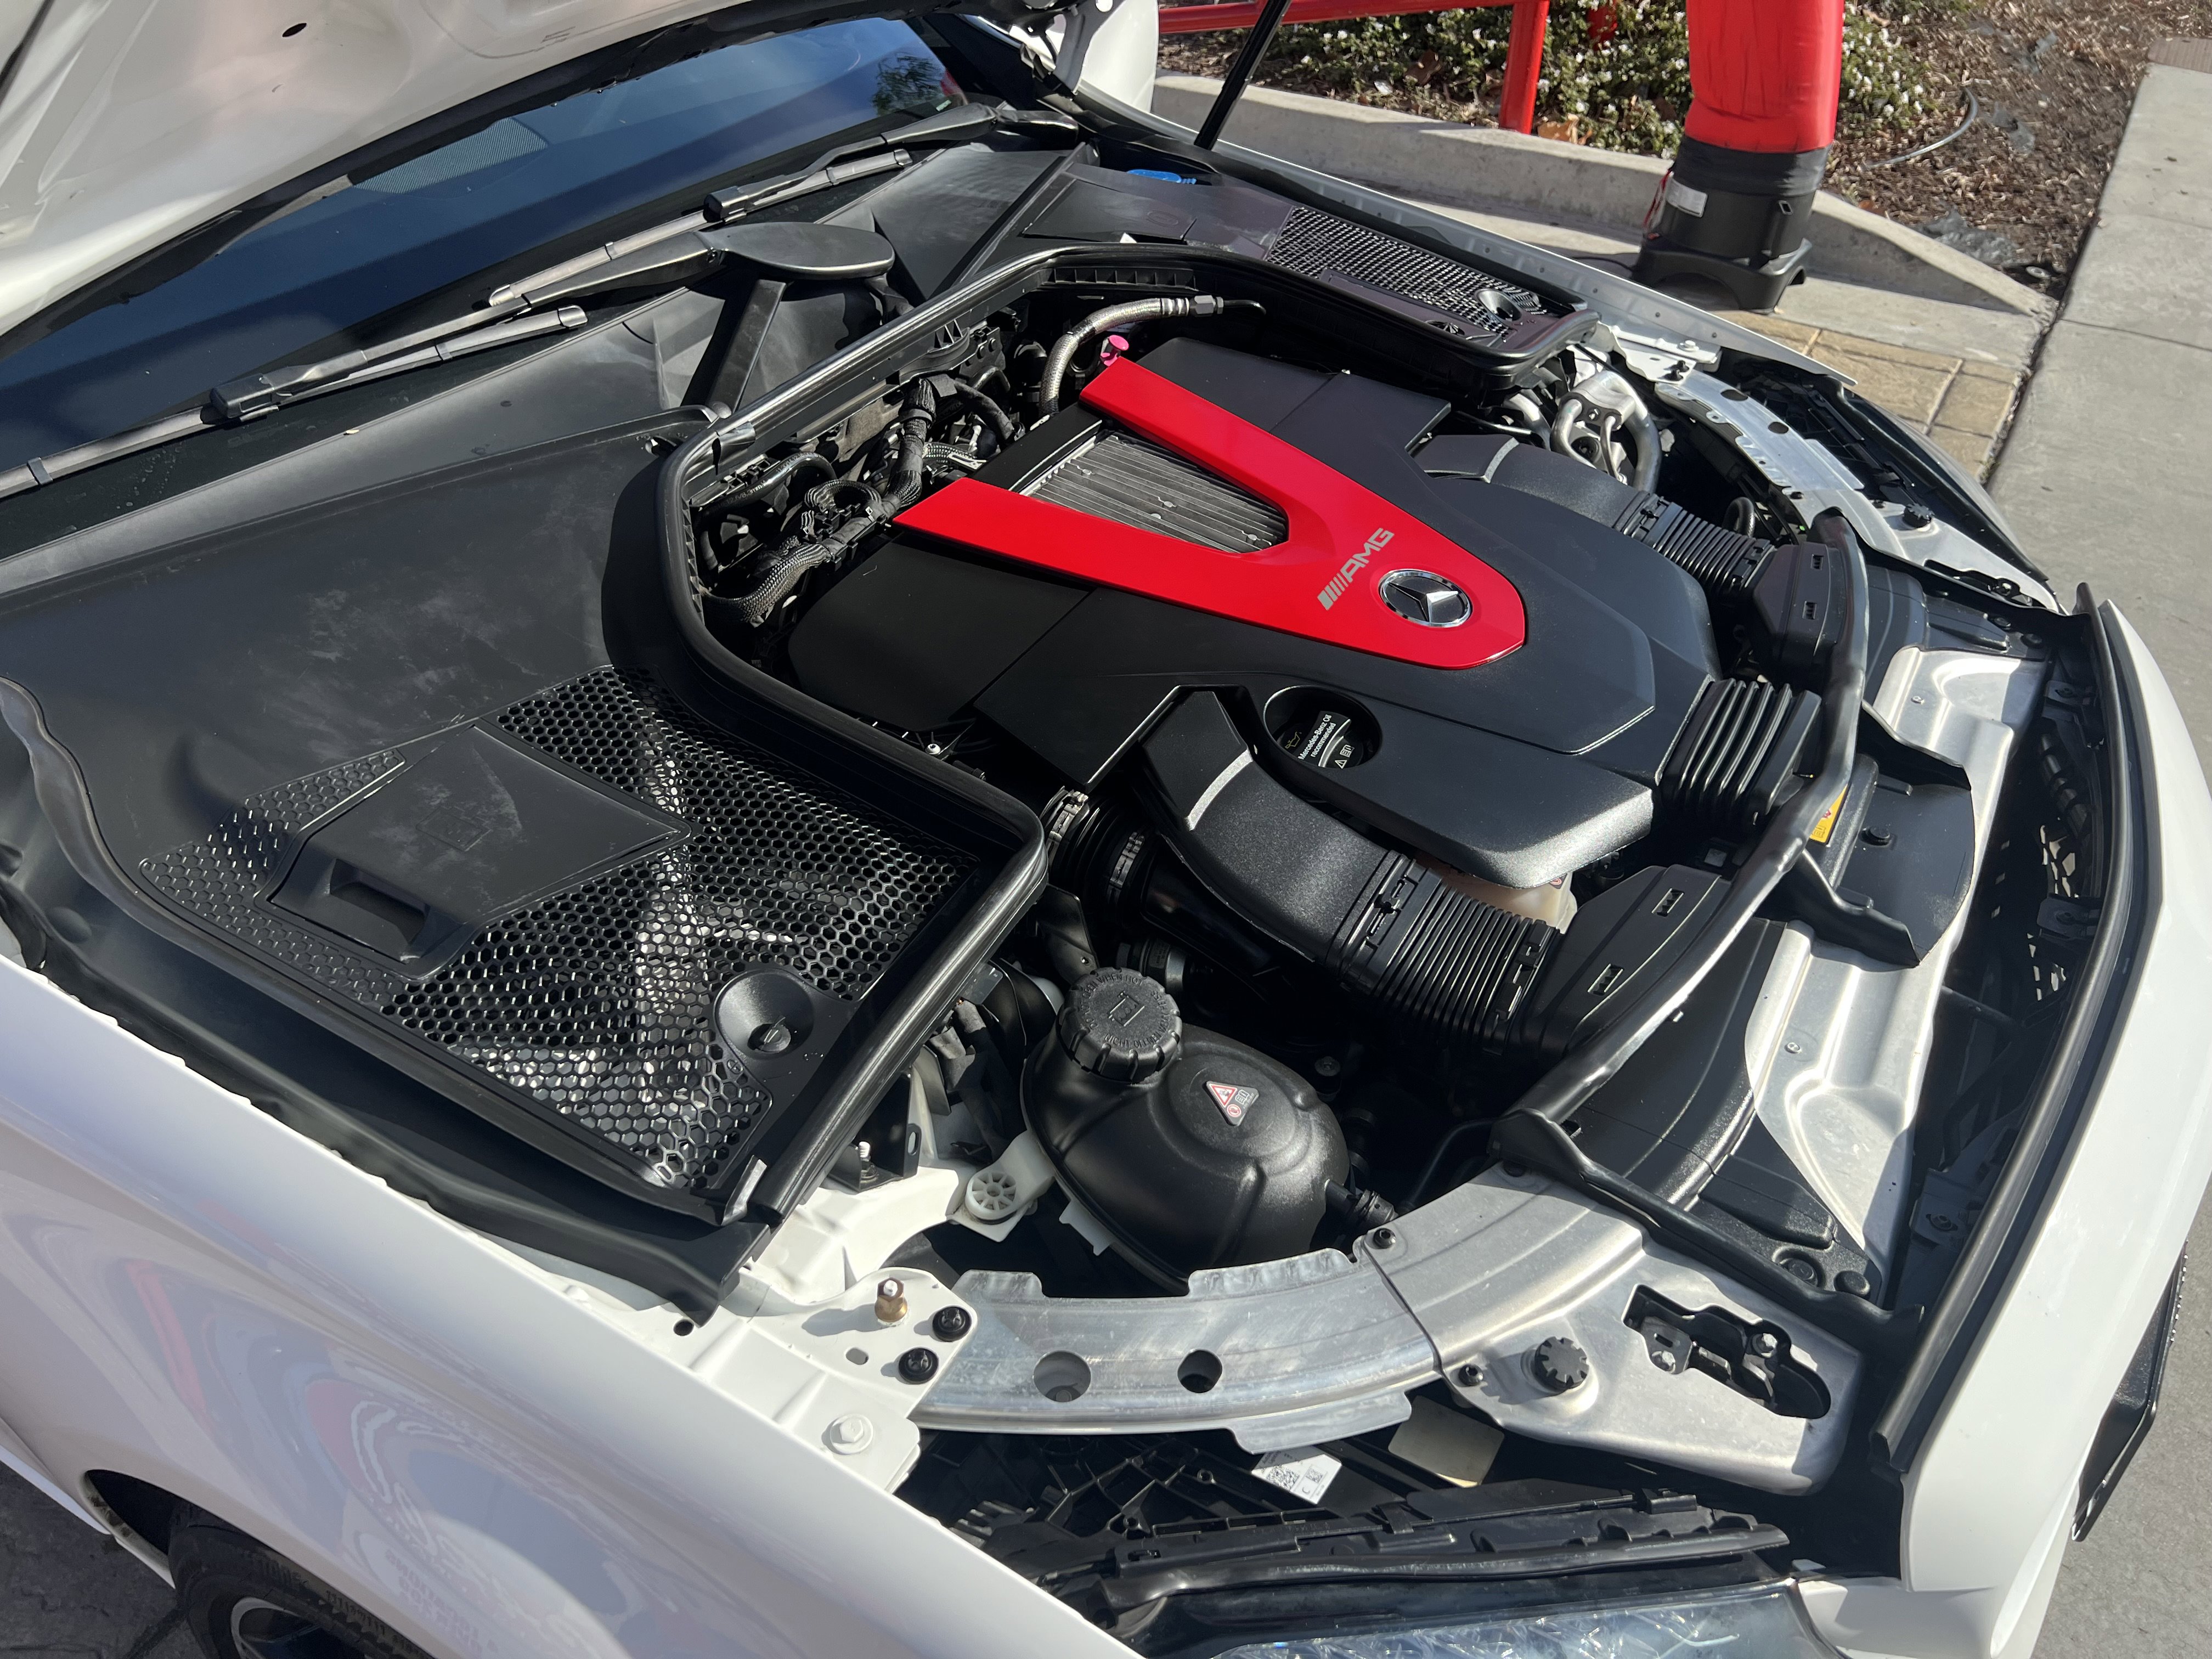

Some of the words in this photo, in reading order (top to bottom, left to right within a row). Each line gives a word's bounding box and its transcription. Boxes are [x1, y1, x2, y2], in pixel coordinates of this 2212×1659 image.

[1340, 527, 1395, 584] AMG
[1298, 721, 1328, 760] Mercedes-Benz
[1323, 714, 1332, 722] Oil
[1310, 722, 1336, 758] recommended
[1125, 974, 1143, 986] HOT
